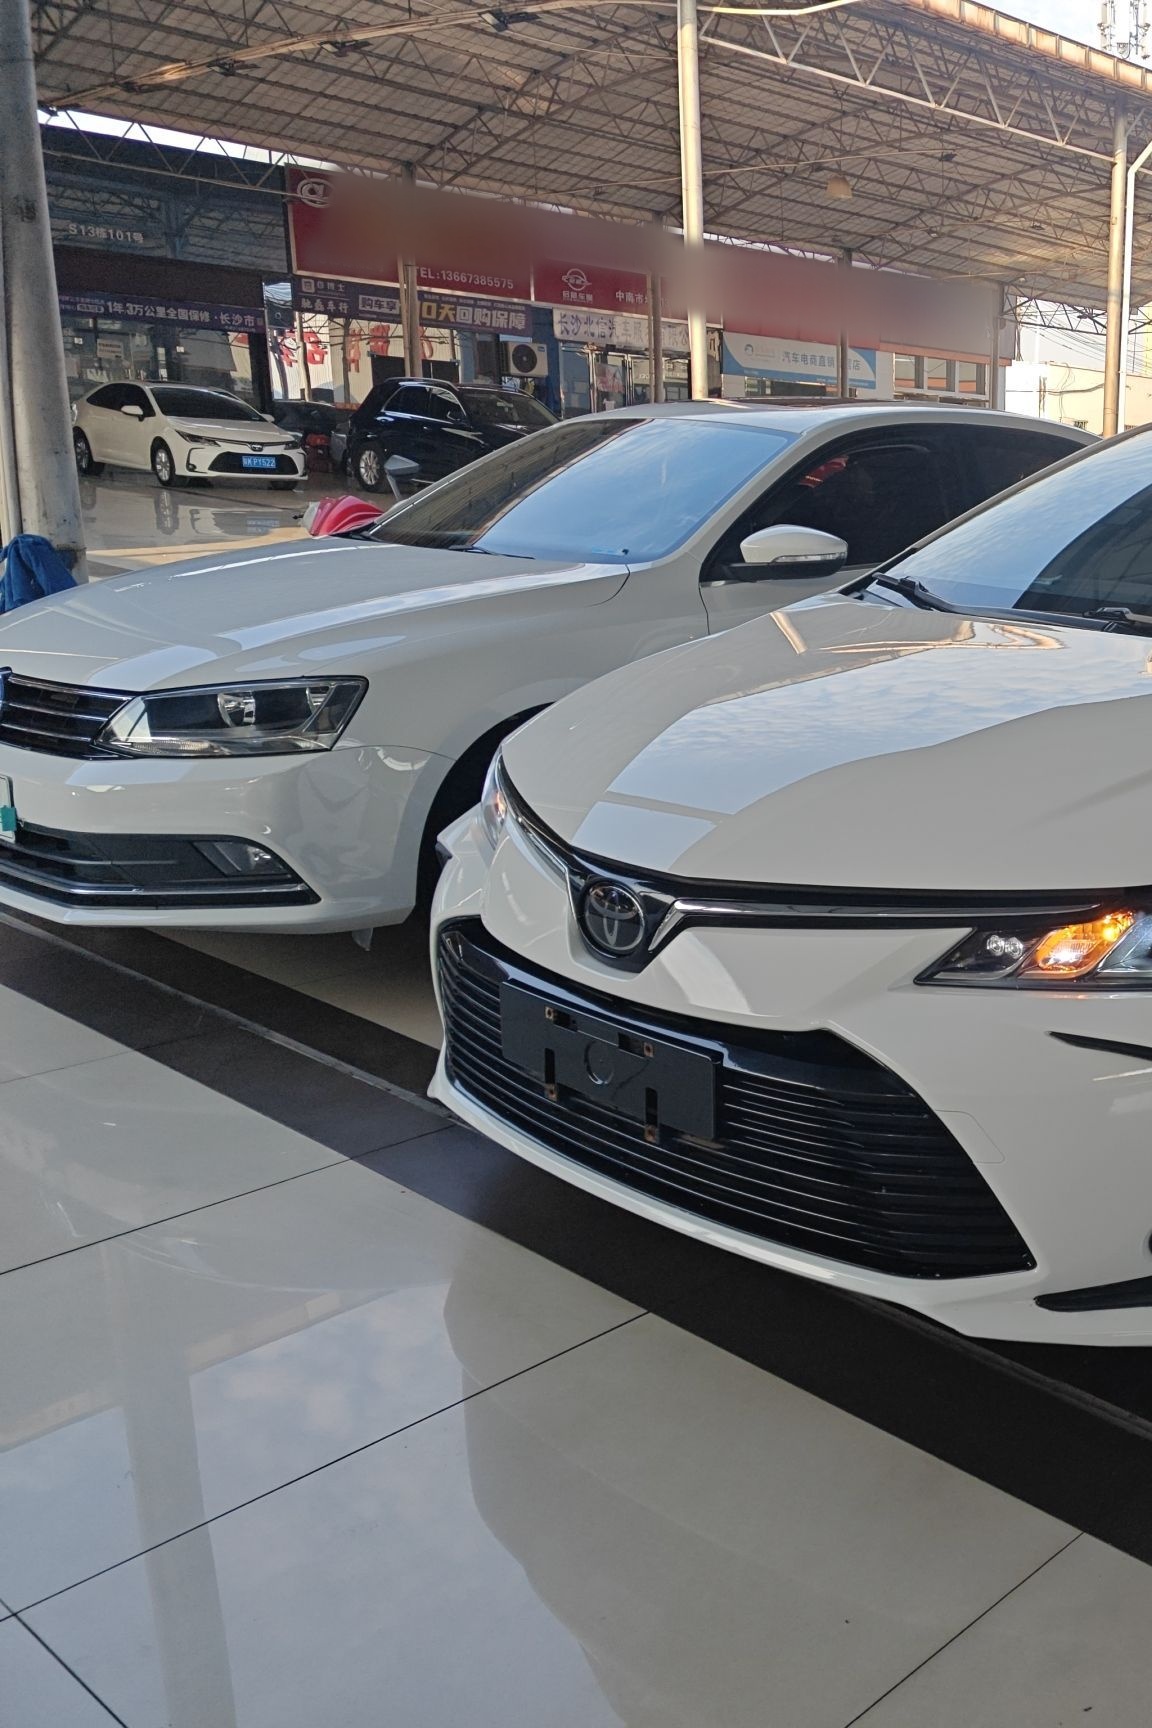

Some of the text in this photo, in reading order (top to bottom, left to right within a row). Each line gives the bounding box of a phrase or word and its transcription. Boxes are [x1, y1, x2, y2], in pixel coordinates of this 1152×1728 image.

[420, 301, 527, 331] 0天回购保障
